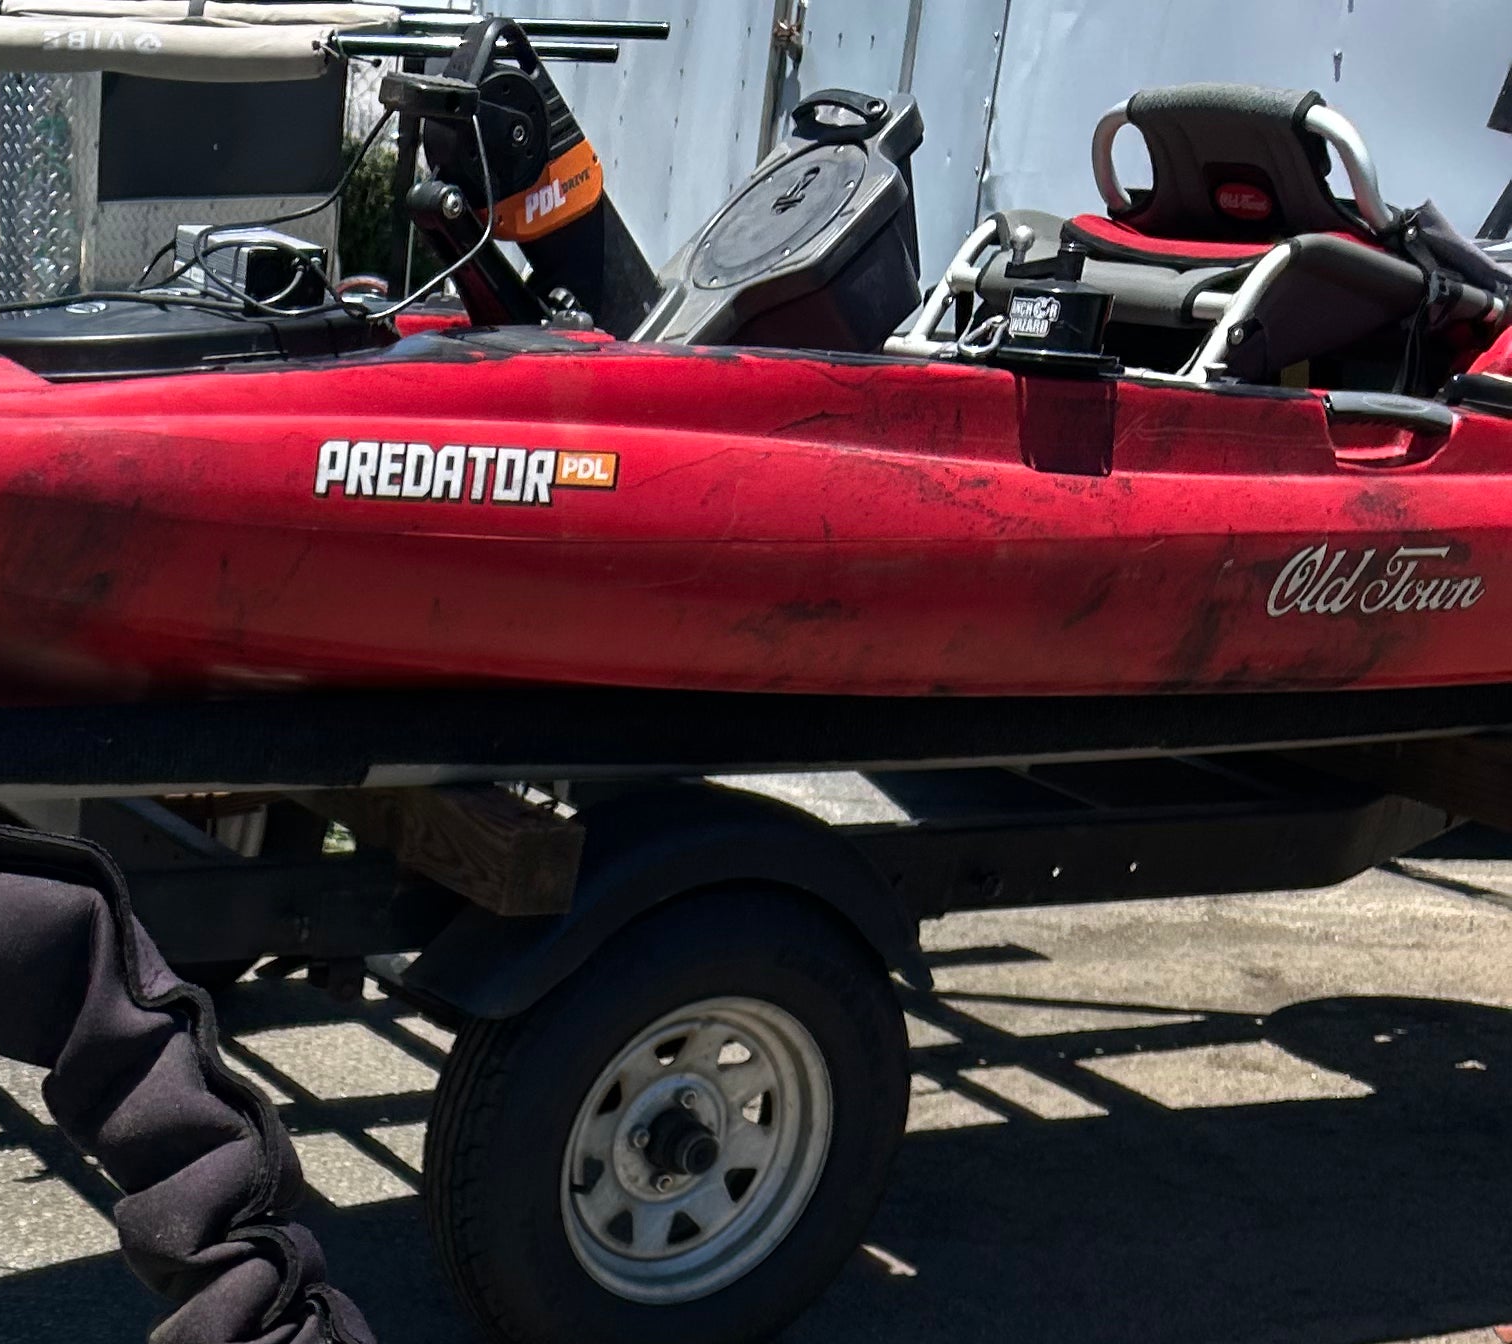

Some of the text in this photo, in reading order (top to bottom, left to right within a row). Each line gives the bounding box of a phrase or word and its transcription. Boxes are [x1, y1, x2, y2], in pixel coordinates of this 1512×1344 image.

[42, 29, 127, 50] VIBE
[525, 167, 591, 224] PDL DRIVE
[314, 440, 609, 503] PREDATOR PDL
[1267, 543, 1486, 617] Old Town
